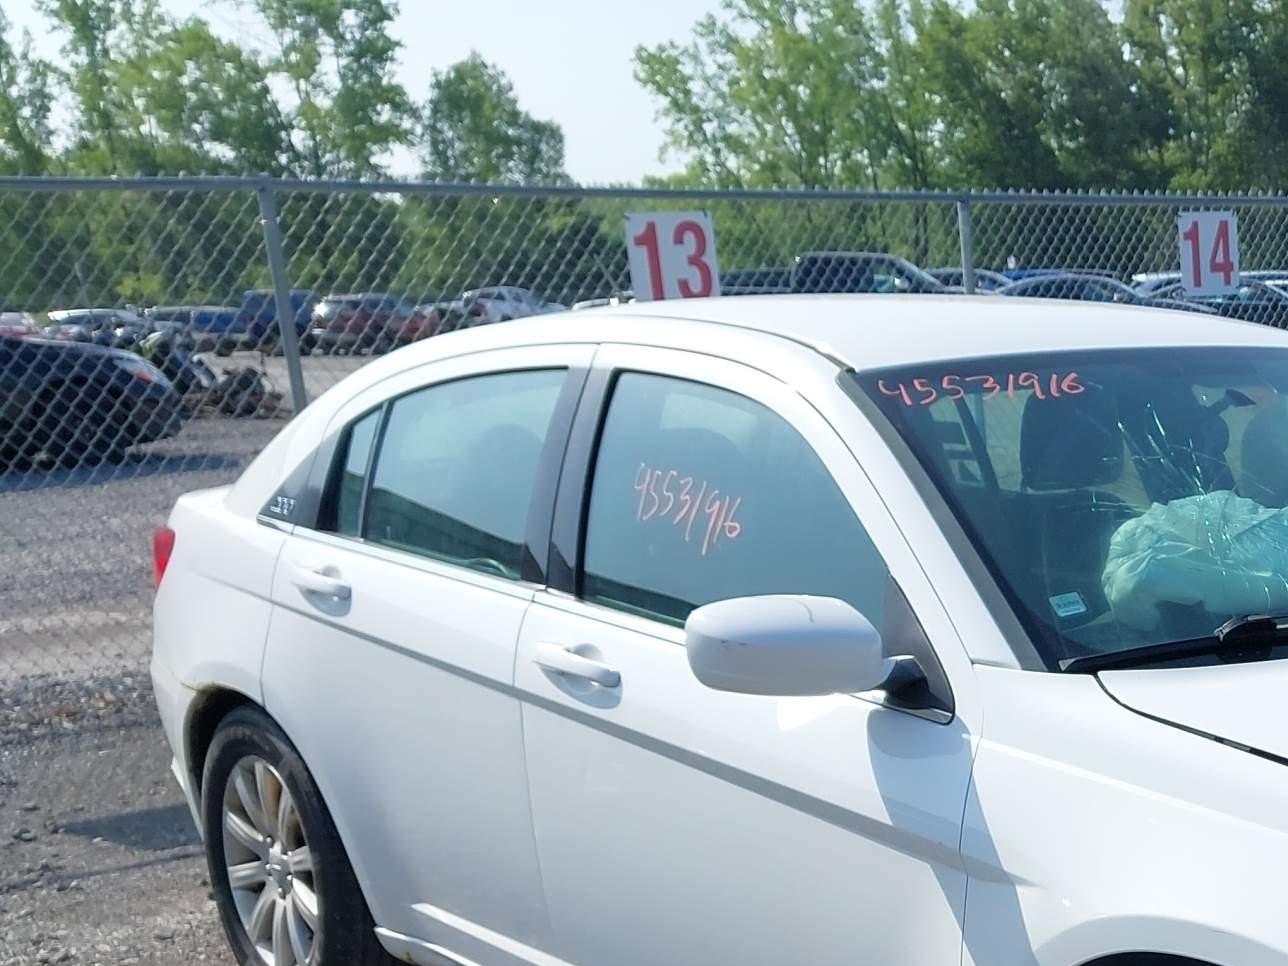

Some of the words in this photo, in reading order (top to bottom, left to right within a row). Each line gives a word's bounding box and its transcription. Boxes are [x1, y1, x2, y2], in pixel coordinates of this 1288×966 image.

[633, 220, 713, 301] 13
[1183, 219, 1234, 288] 14
[878, 372, 1085, 406] 45531916
[634, 461, 742, 556] 45531916
